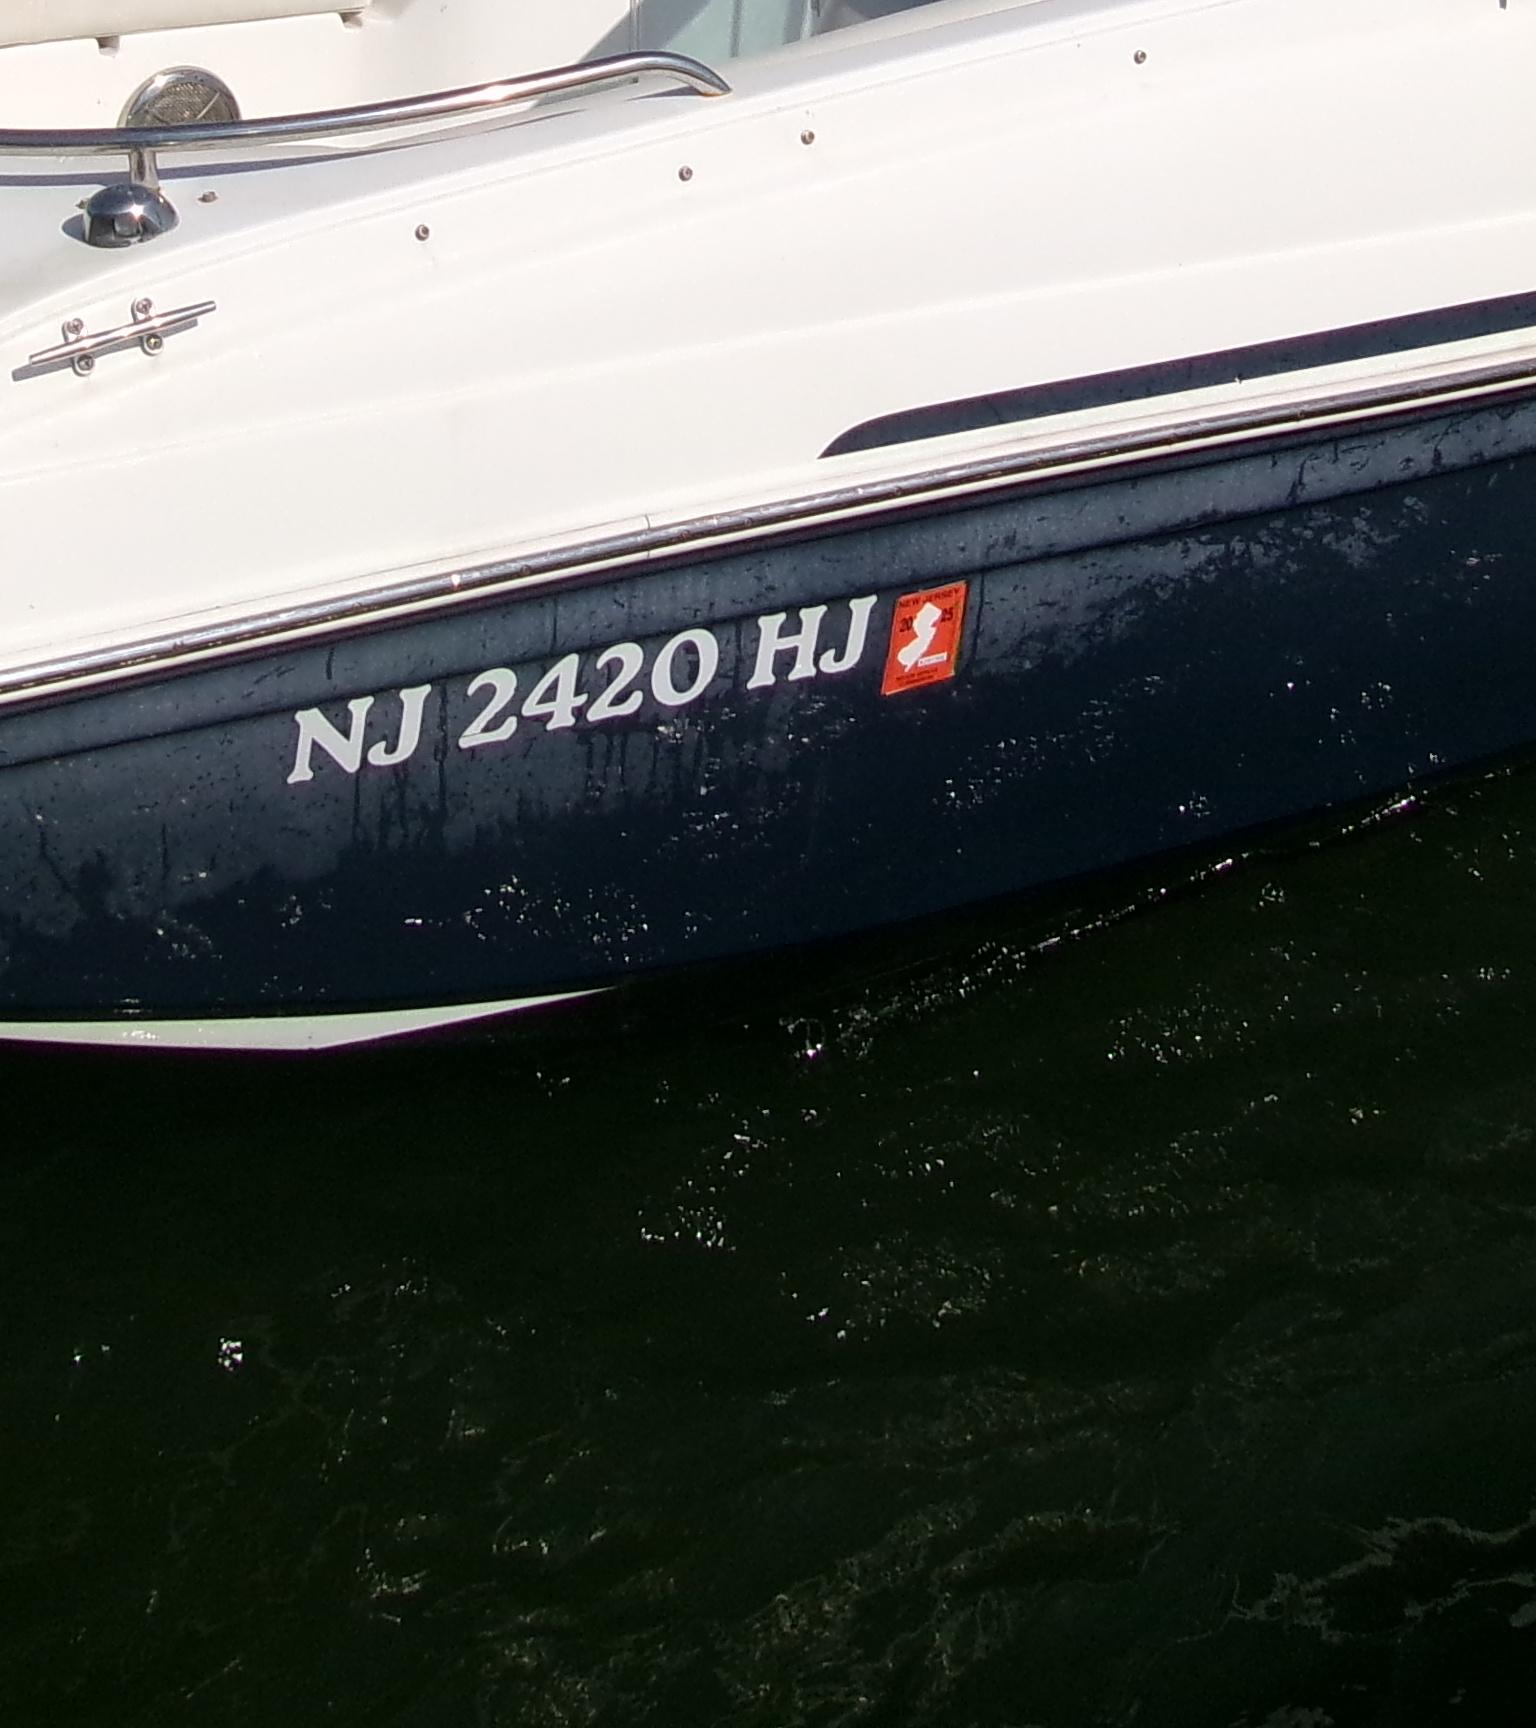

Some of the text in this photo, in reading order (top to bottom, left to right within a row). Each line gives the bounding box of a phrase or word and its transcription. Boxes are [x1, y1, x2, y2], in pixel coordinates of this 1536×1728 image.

[285, 593, 878, 785] NJ 2420 HJ
